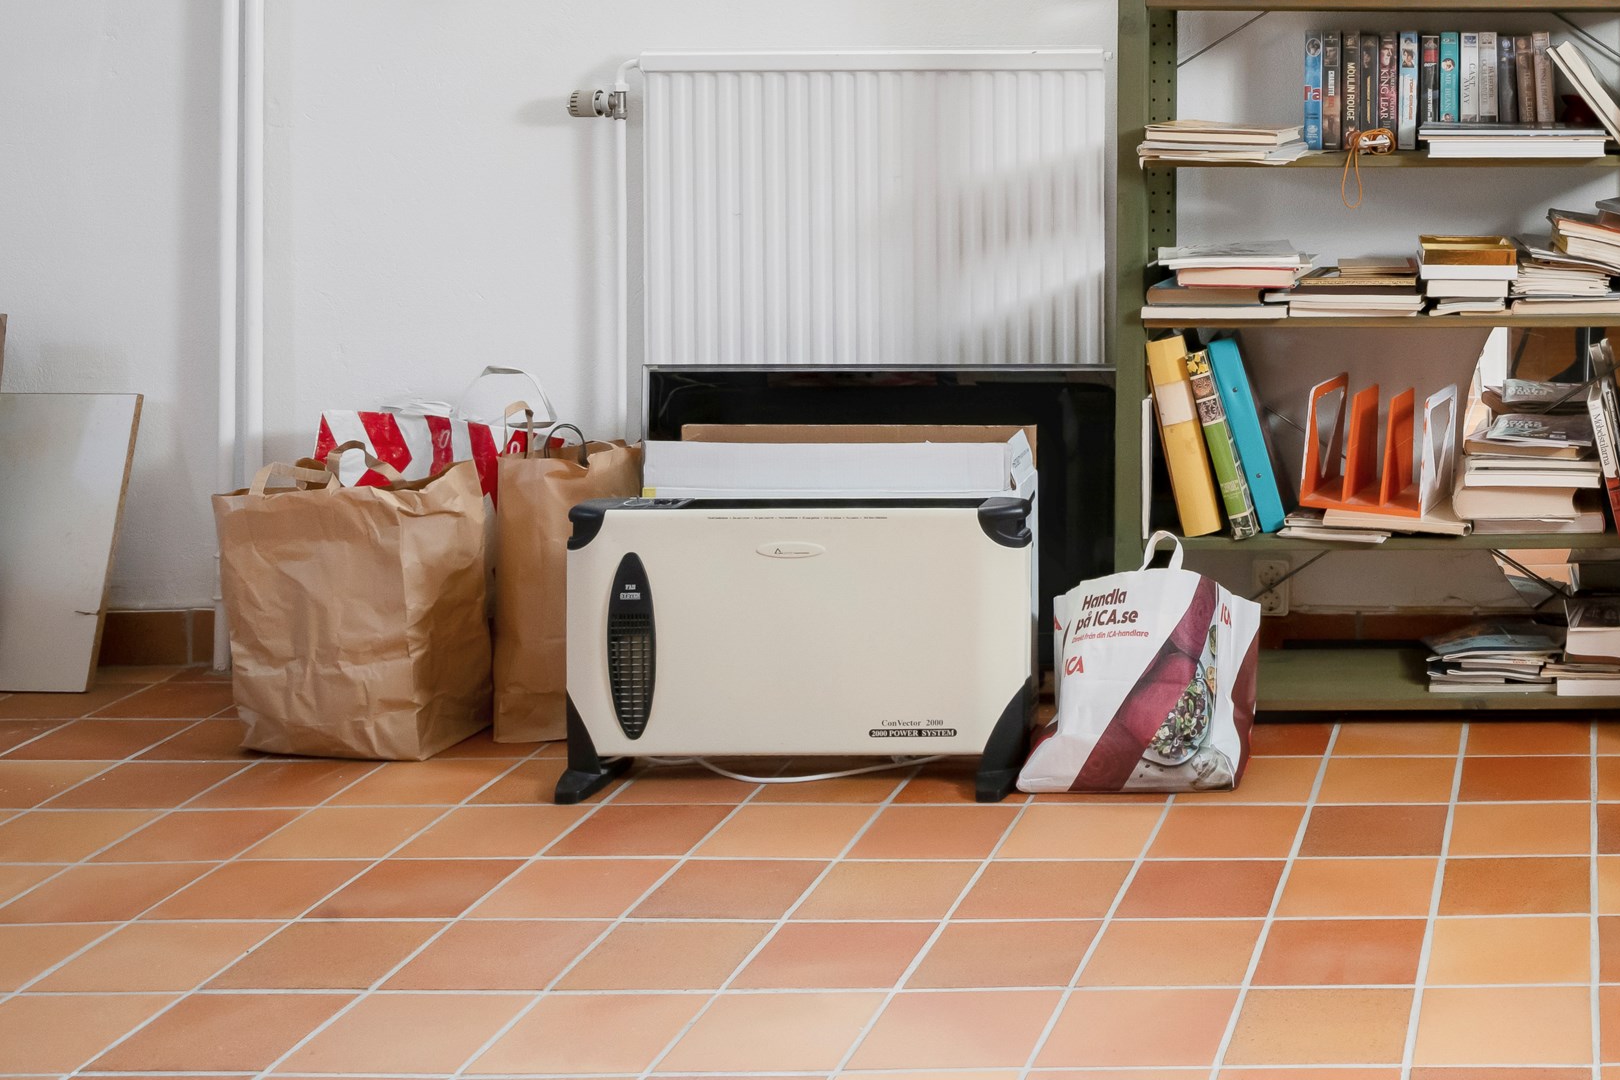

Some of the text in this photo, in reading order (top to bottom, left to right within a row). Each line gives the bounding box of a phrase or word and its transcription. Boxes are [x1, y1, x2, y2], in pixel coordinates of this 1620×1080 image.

[1468, 62, 1476, 87] CAST
[1346, 62, 1356, 121] MOULIN ROUGE
[1380, 69, 1389, 120] KING LEAR
[1592, 413, 1610, 466] Möbelstilarna
[1082, 588, 1127, 611] Handla
[1075, 610, 1092, 635] på
[1092, 609, 1139, 627] ICA.se
[1084, 630, 1096, 641] från
[1097, 631, 1106, 639] din
[1106, 629, 1149, 639] ICA-handlare
[1064, 655, 1084, 677] ICA
[881, 719, 944, 727] ConVector 2000
[889, 729, 919, 737] POWER
[921, 729, 954, 737] SYSTEM
